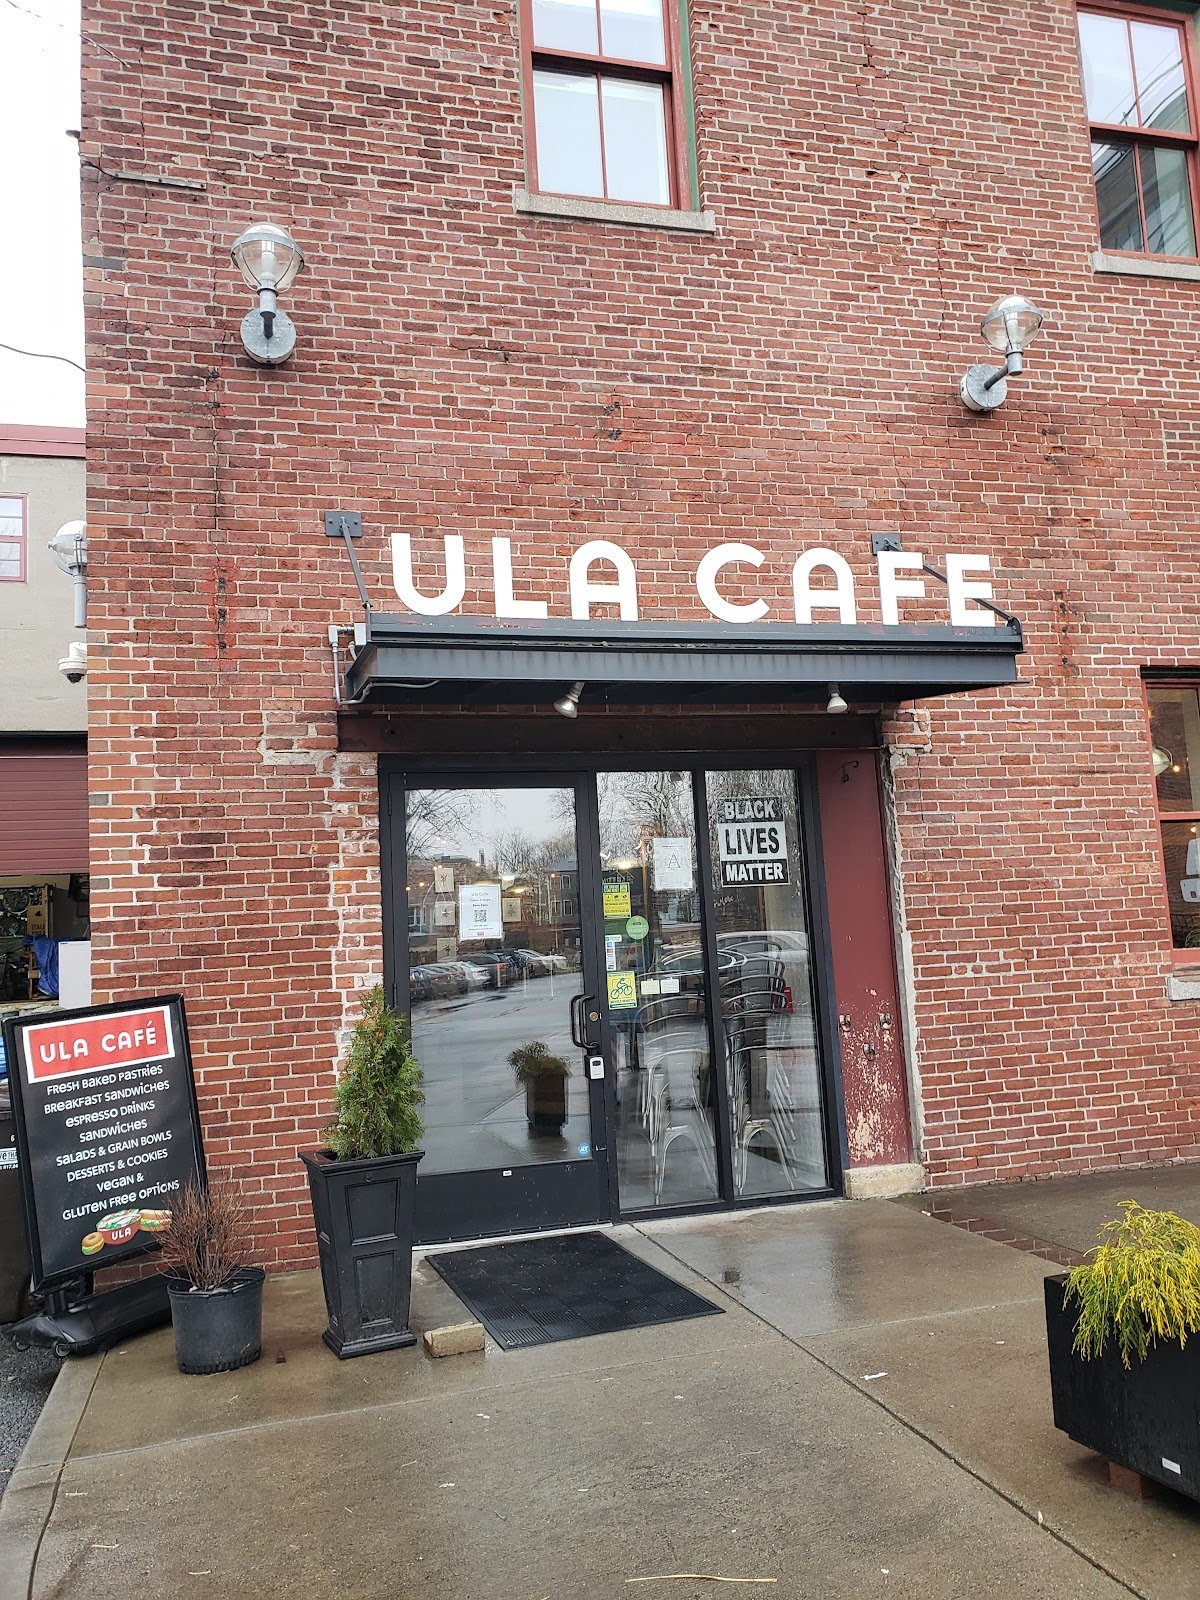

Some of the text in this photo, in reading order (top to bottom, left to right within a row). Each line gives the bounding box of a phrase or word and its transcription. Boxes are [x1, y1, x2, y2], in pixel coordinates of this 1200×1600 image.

[391, 533, 996, 627] ULA CAFE
[725, 800, 775, 820] BLACK
[725, 827, 779, 855] LIVES
[726, 862, 784, 881] MATTER
[39, 1020, 157, 1063] ULA CAFÉ
[98, 1146, 107, 1157] &
[107, 1138, 139, 1154] GRAIN
[140, 1130, 172, 1146] BOWLS
[66, 1148, 168, 1182] DESSERTS & COOKIES
[136, 1172, 145, 1182] &
[111, 1227, 132, 1241] ULA
